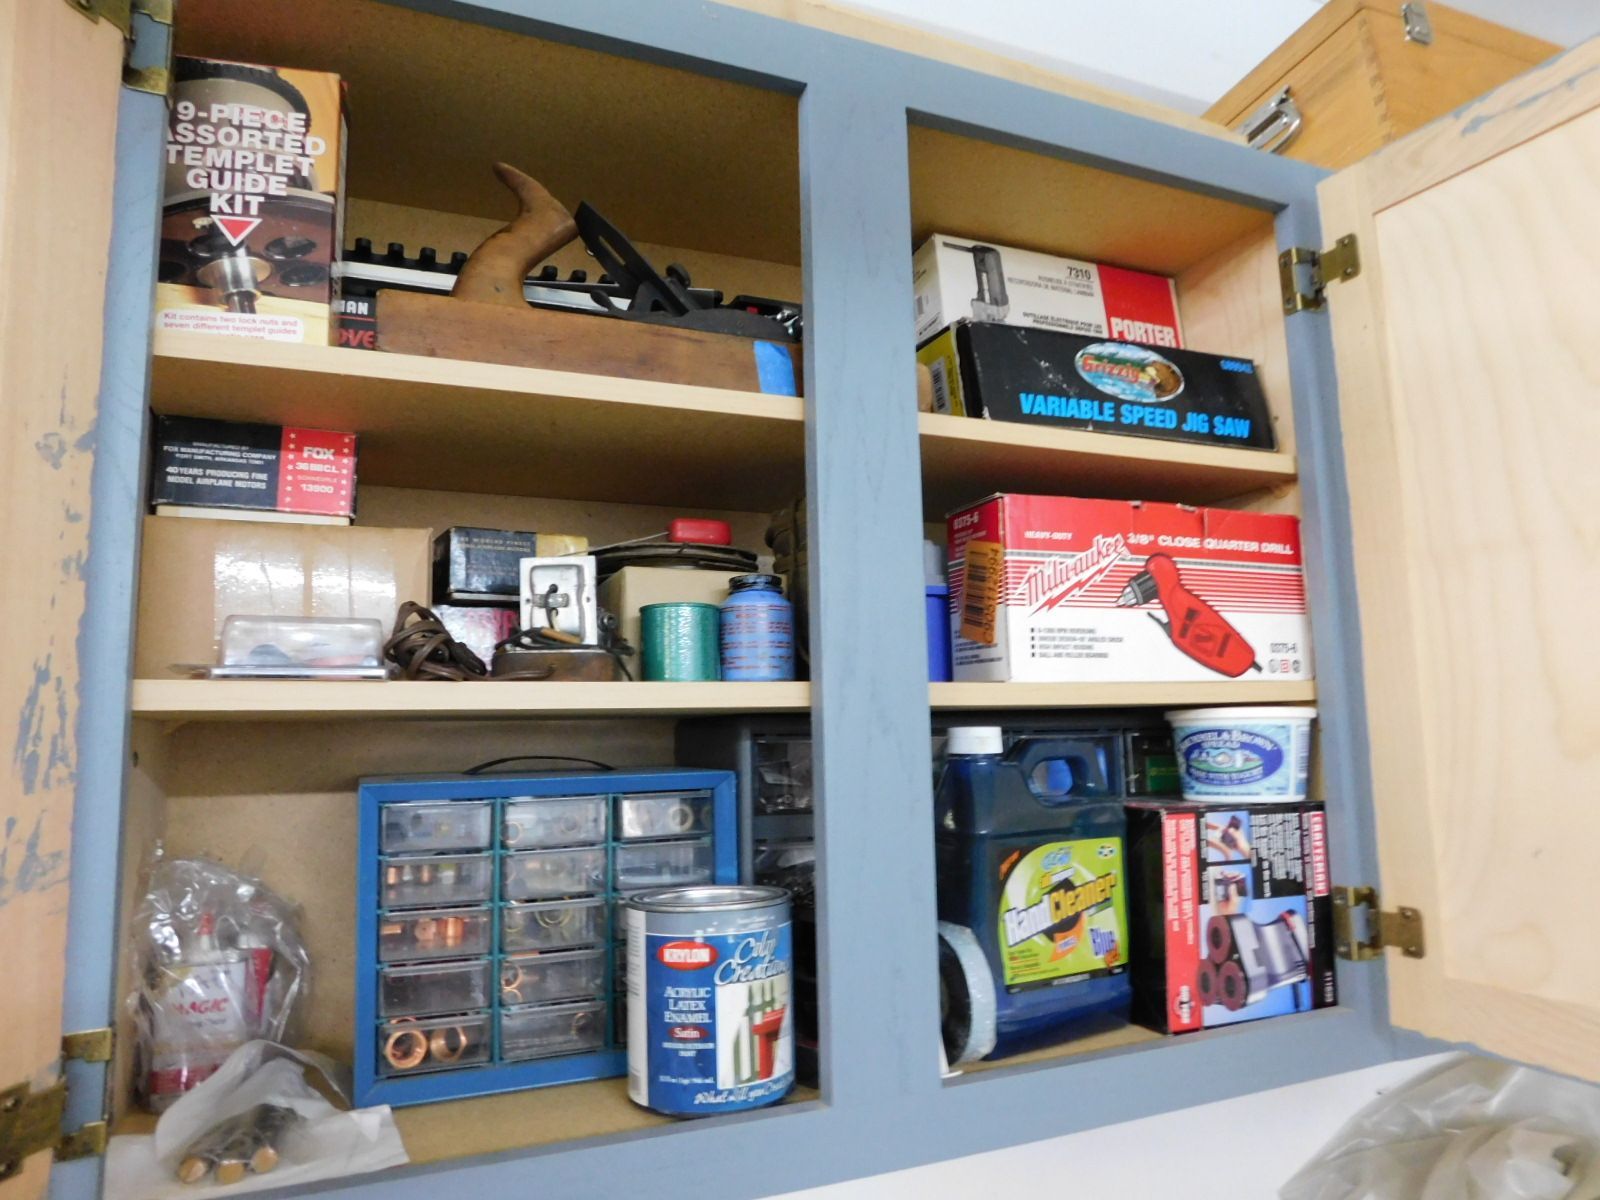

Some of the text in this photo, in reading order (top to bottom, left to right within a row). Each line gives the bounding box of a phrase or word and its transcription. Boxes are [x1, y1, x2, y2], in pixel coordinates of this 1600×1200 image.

[177, 101, 306, 133] 9-PIECE
[166, 144, 315, 177] TEMPLET
[186, 168, 288, 196] GUIDE
[210, 192, 265, 215] KIT
[1109, 316, 1177, 347] PORTER
[1081, 354, 1141, 384] Grizzly
[1019, 392, 1251, 439] VARIABLE SPEED JIG SAW
[303, 446, 335, 461] FOX
[179, 466, 204, 476] YEARS
[1157, 534, 1202, 549] CLOSE
[1203, 537, 1260, 553] QUARTER
[1260, 542, 1294, 555] DRILL
[1014, 532, 1131, 608] Milwaukee
[1312, 814, 1327, 892] CRAFTSMAN
[1004, 894, 1053, 947] Hand
[1050, 873, 1117, 923] Cleaner
[663, 986, 712, 998] ACRYLIC
[668, 999, 707, 1011] LATEX
[664, 1011, 713, 1023] ENAMEL
[673, 1027, 701, 1038] Satin
